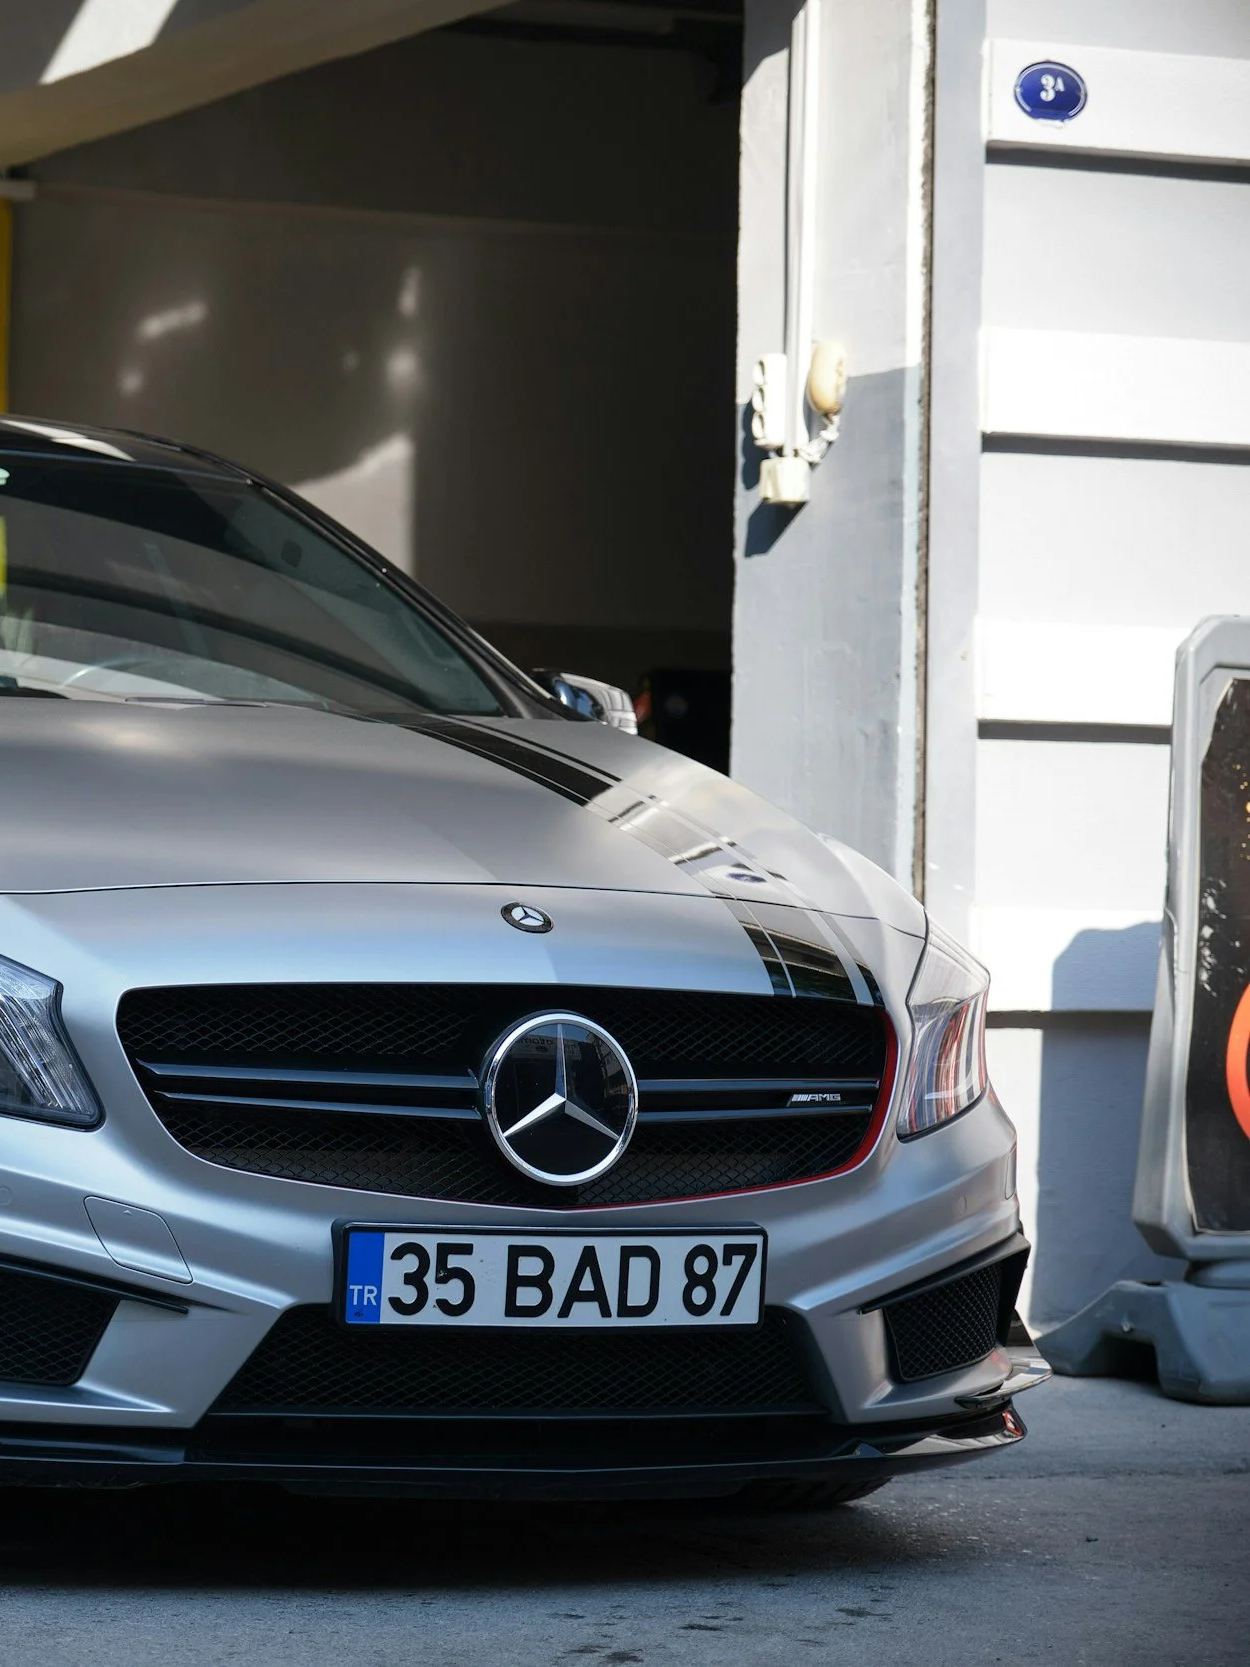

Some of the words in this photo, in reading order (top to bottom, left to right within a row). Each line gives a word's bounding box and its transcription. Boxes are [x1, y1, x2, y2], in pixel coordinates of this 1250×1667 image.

[806, 1093, 841, 1102] AMG
[388, 1241, 476, 1317] 35
[504, 1243, 661, 1318] BAD
[681, 1243, 758, 1317] 87
[349, 1284, 378, 1306] TR
